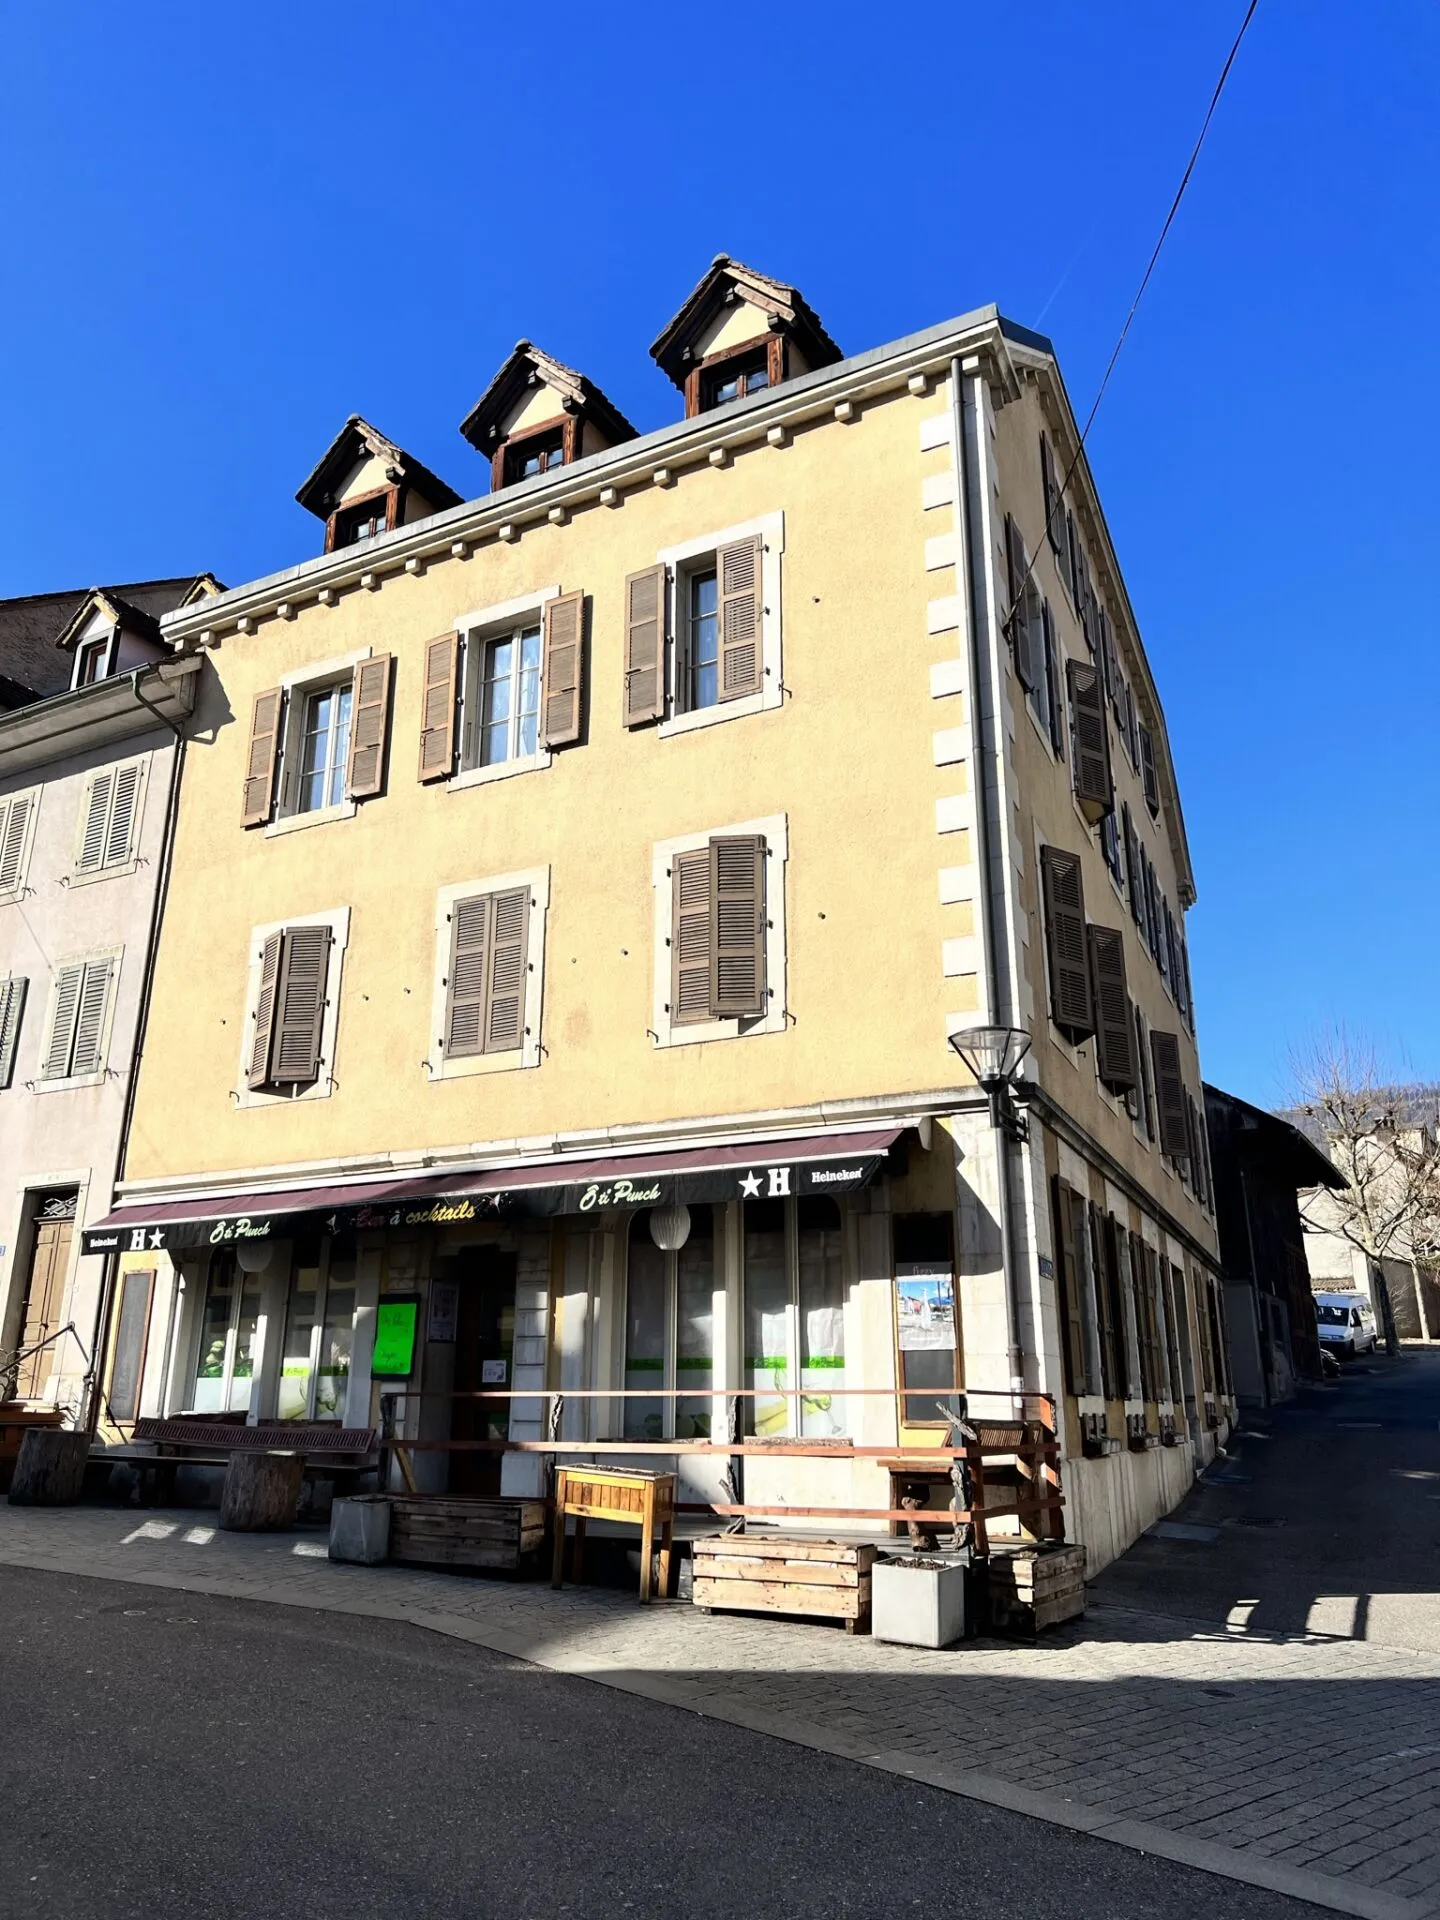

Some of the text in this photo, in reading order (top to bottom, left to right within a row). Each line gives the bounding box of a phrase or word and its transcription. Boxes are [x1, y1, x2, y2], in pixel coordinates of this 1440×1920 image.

[768, 1167, 791, 1197] H
[811, 1167, 863, 1183] Heineken
[579, 1184, 600, 1211] Ô
[613, 1180, 661, 1205] Punch
[405, 1199, 477, 1225] cocktails
[130, 1229, 147, 1250] H
[209, 1220, 226, 1244] Ô
[234, 1218, 271, 1239] Punch
